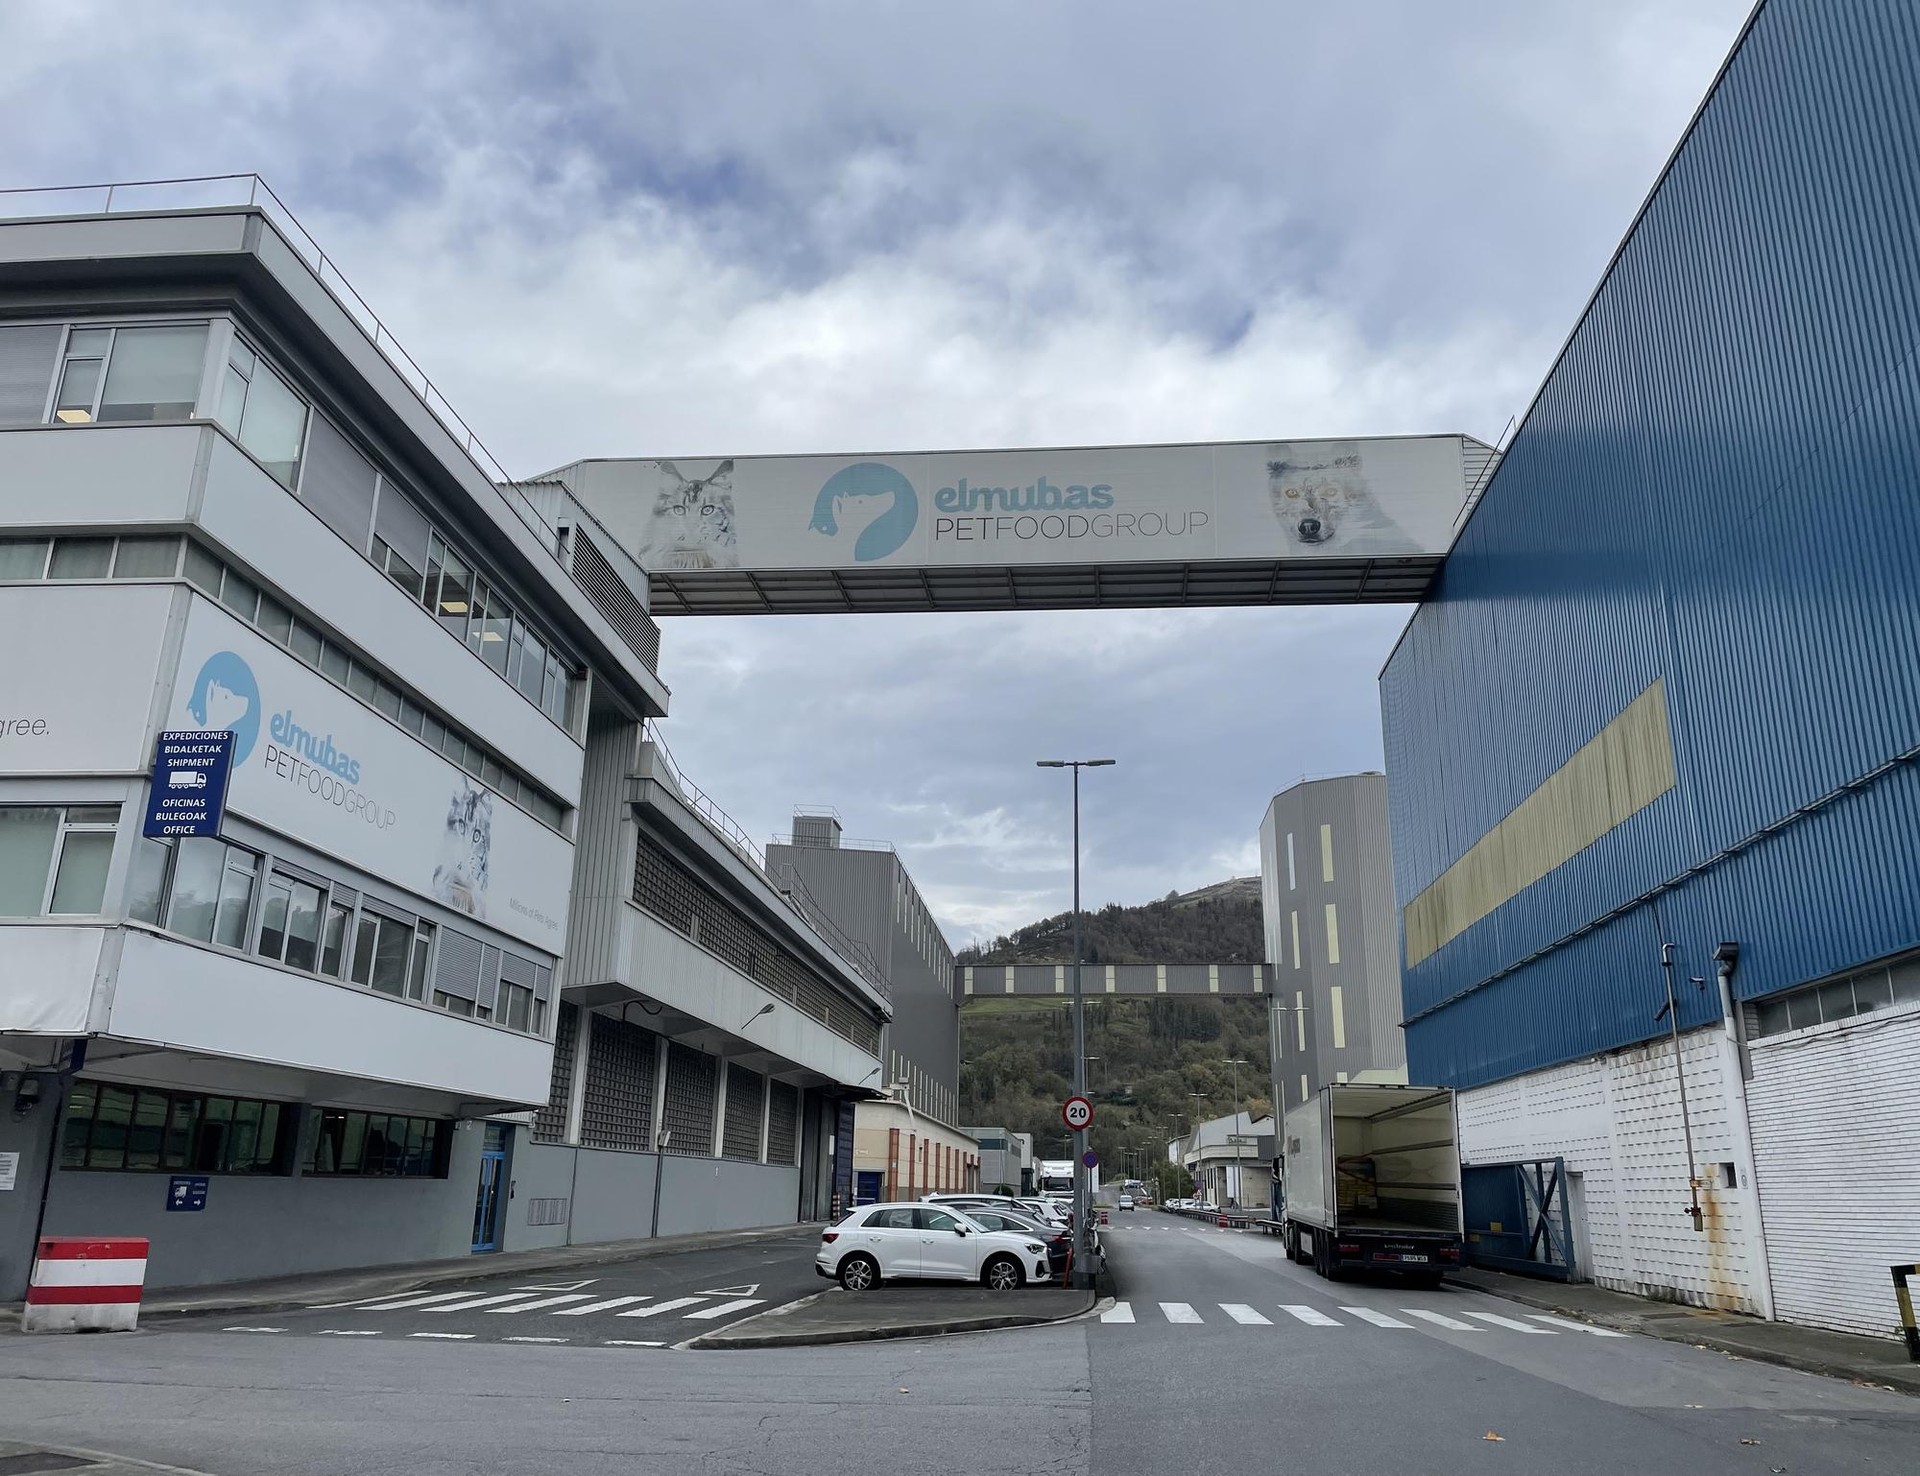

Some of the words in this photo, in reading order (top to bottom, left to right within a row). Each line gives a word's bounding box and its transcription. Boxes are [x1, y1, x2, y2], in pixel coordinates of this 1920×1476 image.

[934, 476, 1115, 514] elmubas
[935, 511, 1210, 541] PETFOODGROUP
[163, 732, 229, 741] EXPEDICIONES
[164, 744, 222, 754] BIDALKETAK
[270, 710, 361, 785] elmubas
[167, 758, 215, 767] SHIPMENT
[264, 744, 396, 831] PETFOODGROUP
[162, 798, 206, 807] OFICINAS
[155, 811, 207, 821] BULEGOAK
[163, 825, 195, 834] OFFICE
[1069, 1107, 1087, 1118] 20
